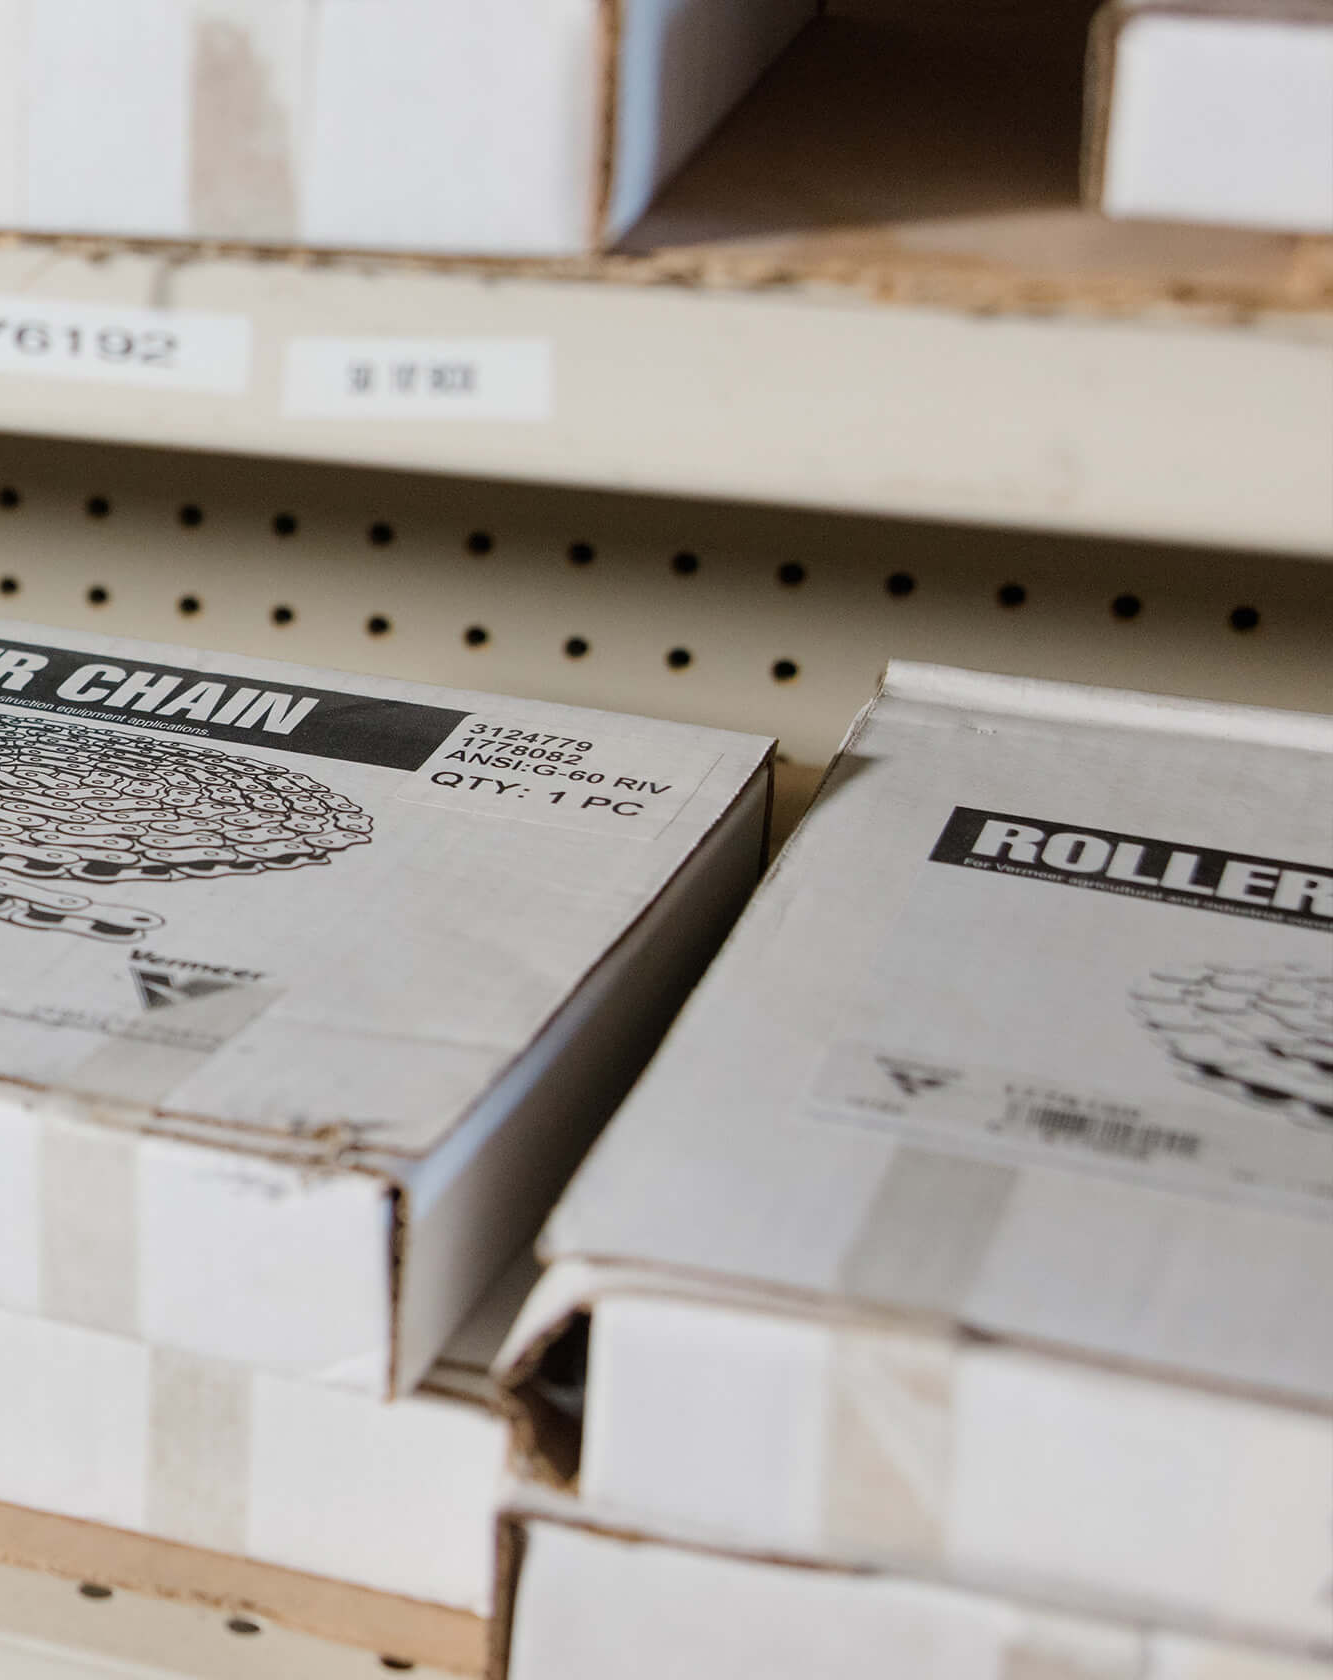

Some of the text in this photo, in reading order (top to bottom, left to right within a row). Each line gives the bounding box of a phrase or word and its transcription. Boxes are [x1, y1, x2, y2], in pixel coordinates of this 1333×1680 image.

[55, 663, 321, 736] CHAIN
[56, 702, 128, 726] equipment
[129, 714, 211, 737] applications.
[461, 736, 584, 766] 1778082
[469, 723, 594, 753] 3124779
[430, 771, 646, 817] QTY: 1 PC
[444, 749, 673, 795] ANSI:G-60 RIV
[971, 818, 1333, 918] ROLLER
